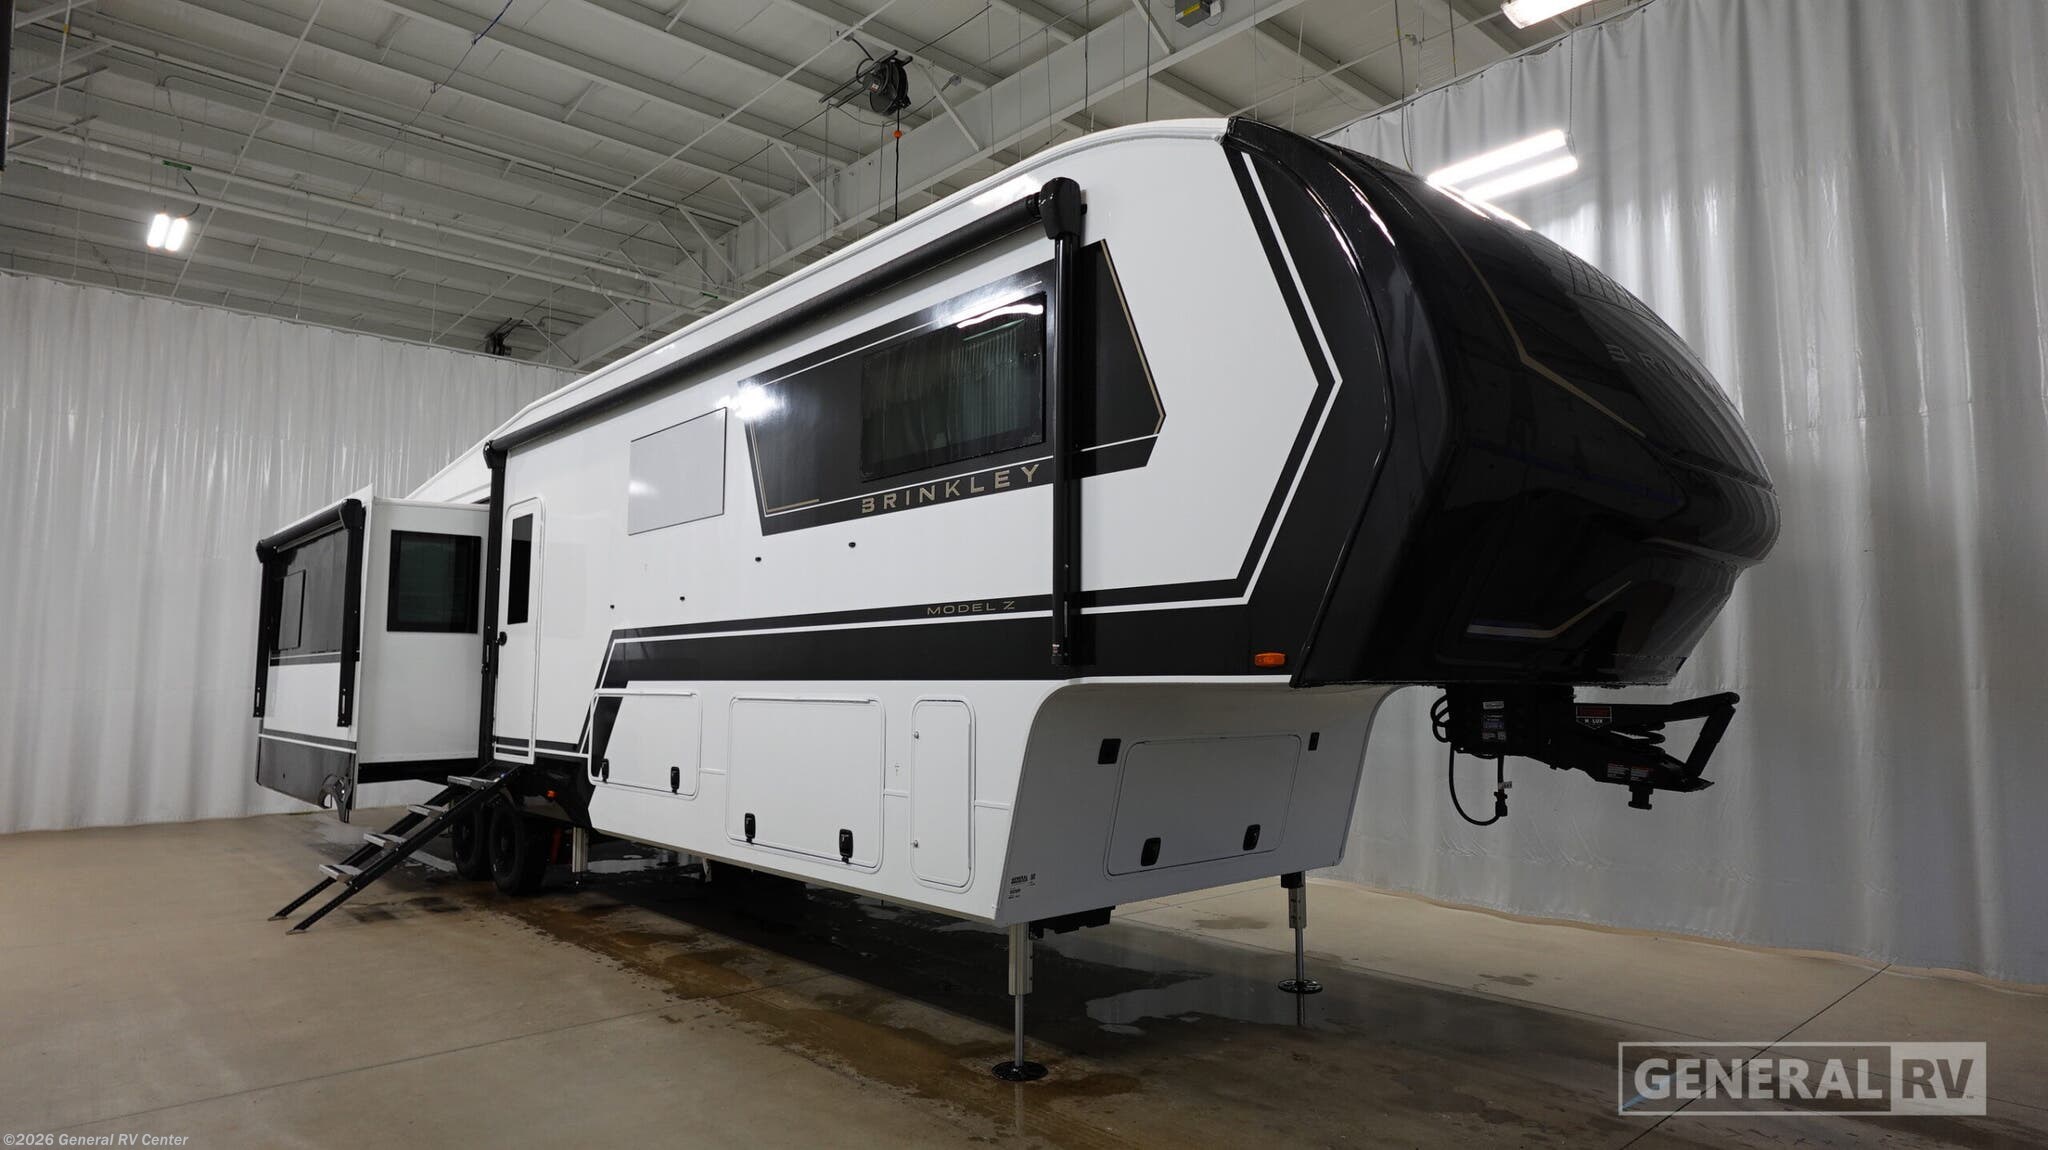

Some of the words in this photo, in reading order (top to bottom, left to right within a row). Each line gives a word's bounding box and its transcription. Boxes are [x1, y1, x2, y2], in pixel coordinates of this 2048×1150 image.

[862, 464, 1039, 513] BRINKLEY
[927, 603, 996, 616] MODEL
[1003, 601, 1015, 610] Z
